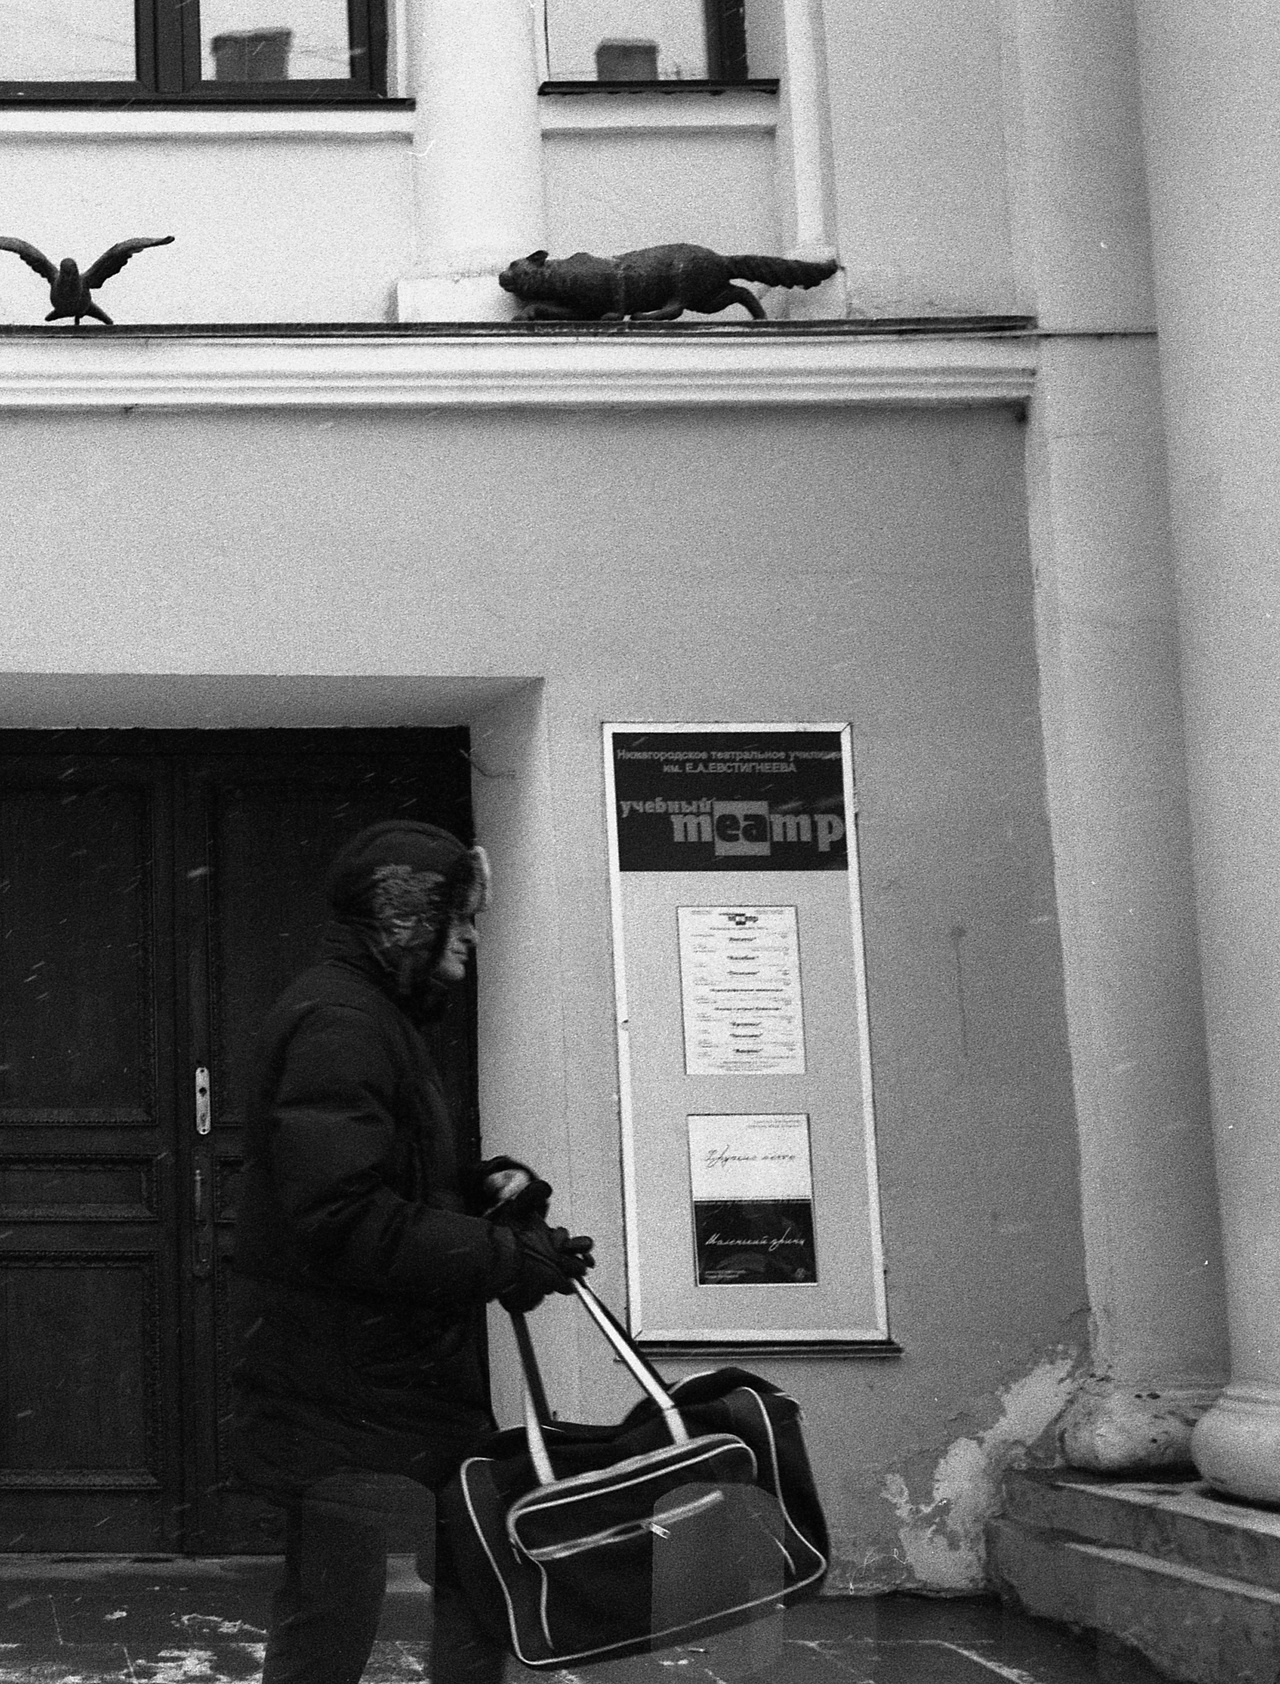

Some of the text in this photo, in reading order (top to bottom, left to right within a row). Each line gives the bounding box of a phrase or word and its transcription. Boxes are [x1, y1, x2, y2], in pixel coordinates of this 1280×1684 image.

[710, 750, 786, 761] театральное
[620, 797, 712, 817] учебный
[671, 813, 845, 852] театр
